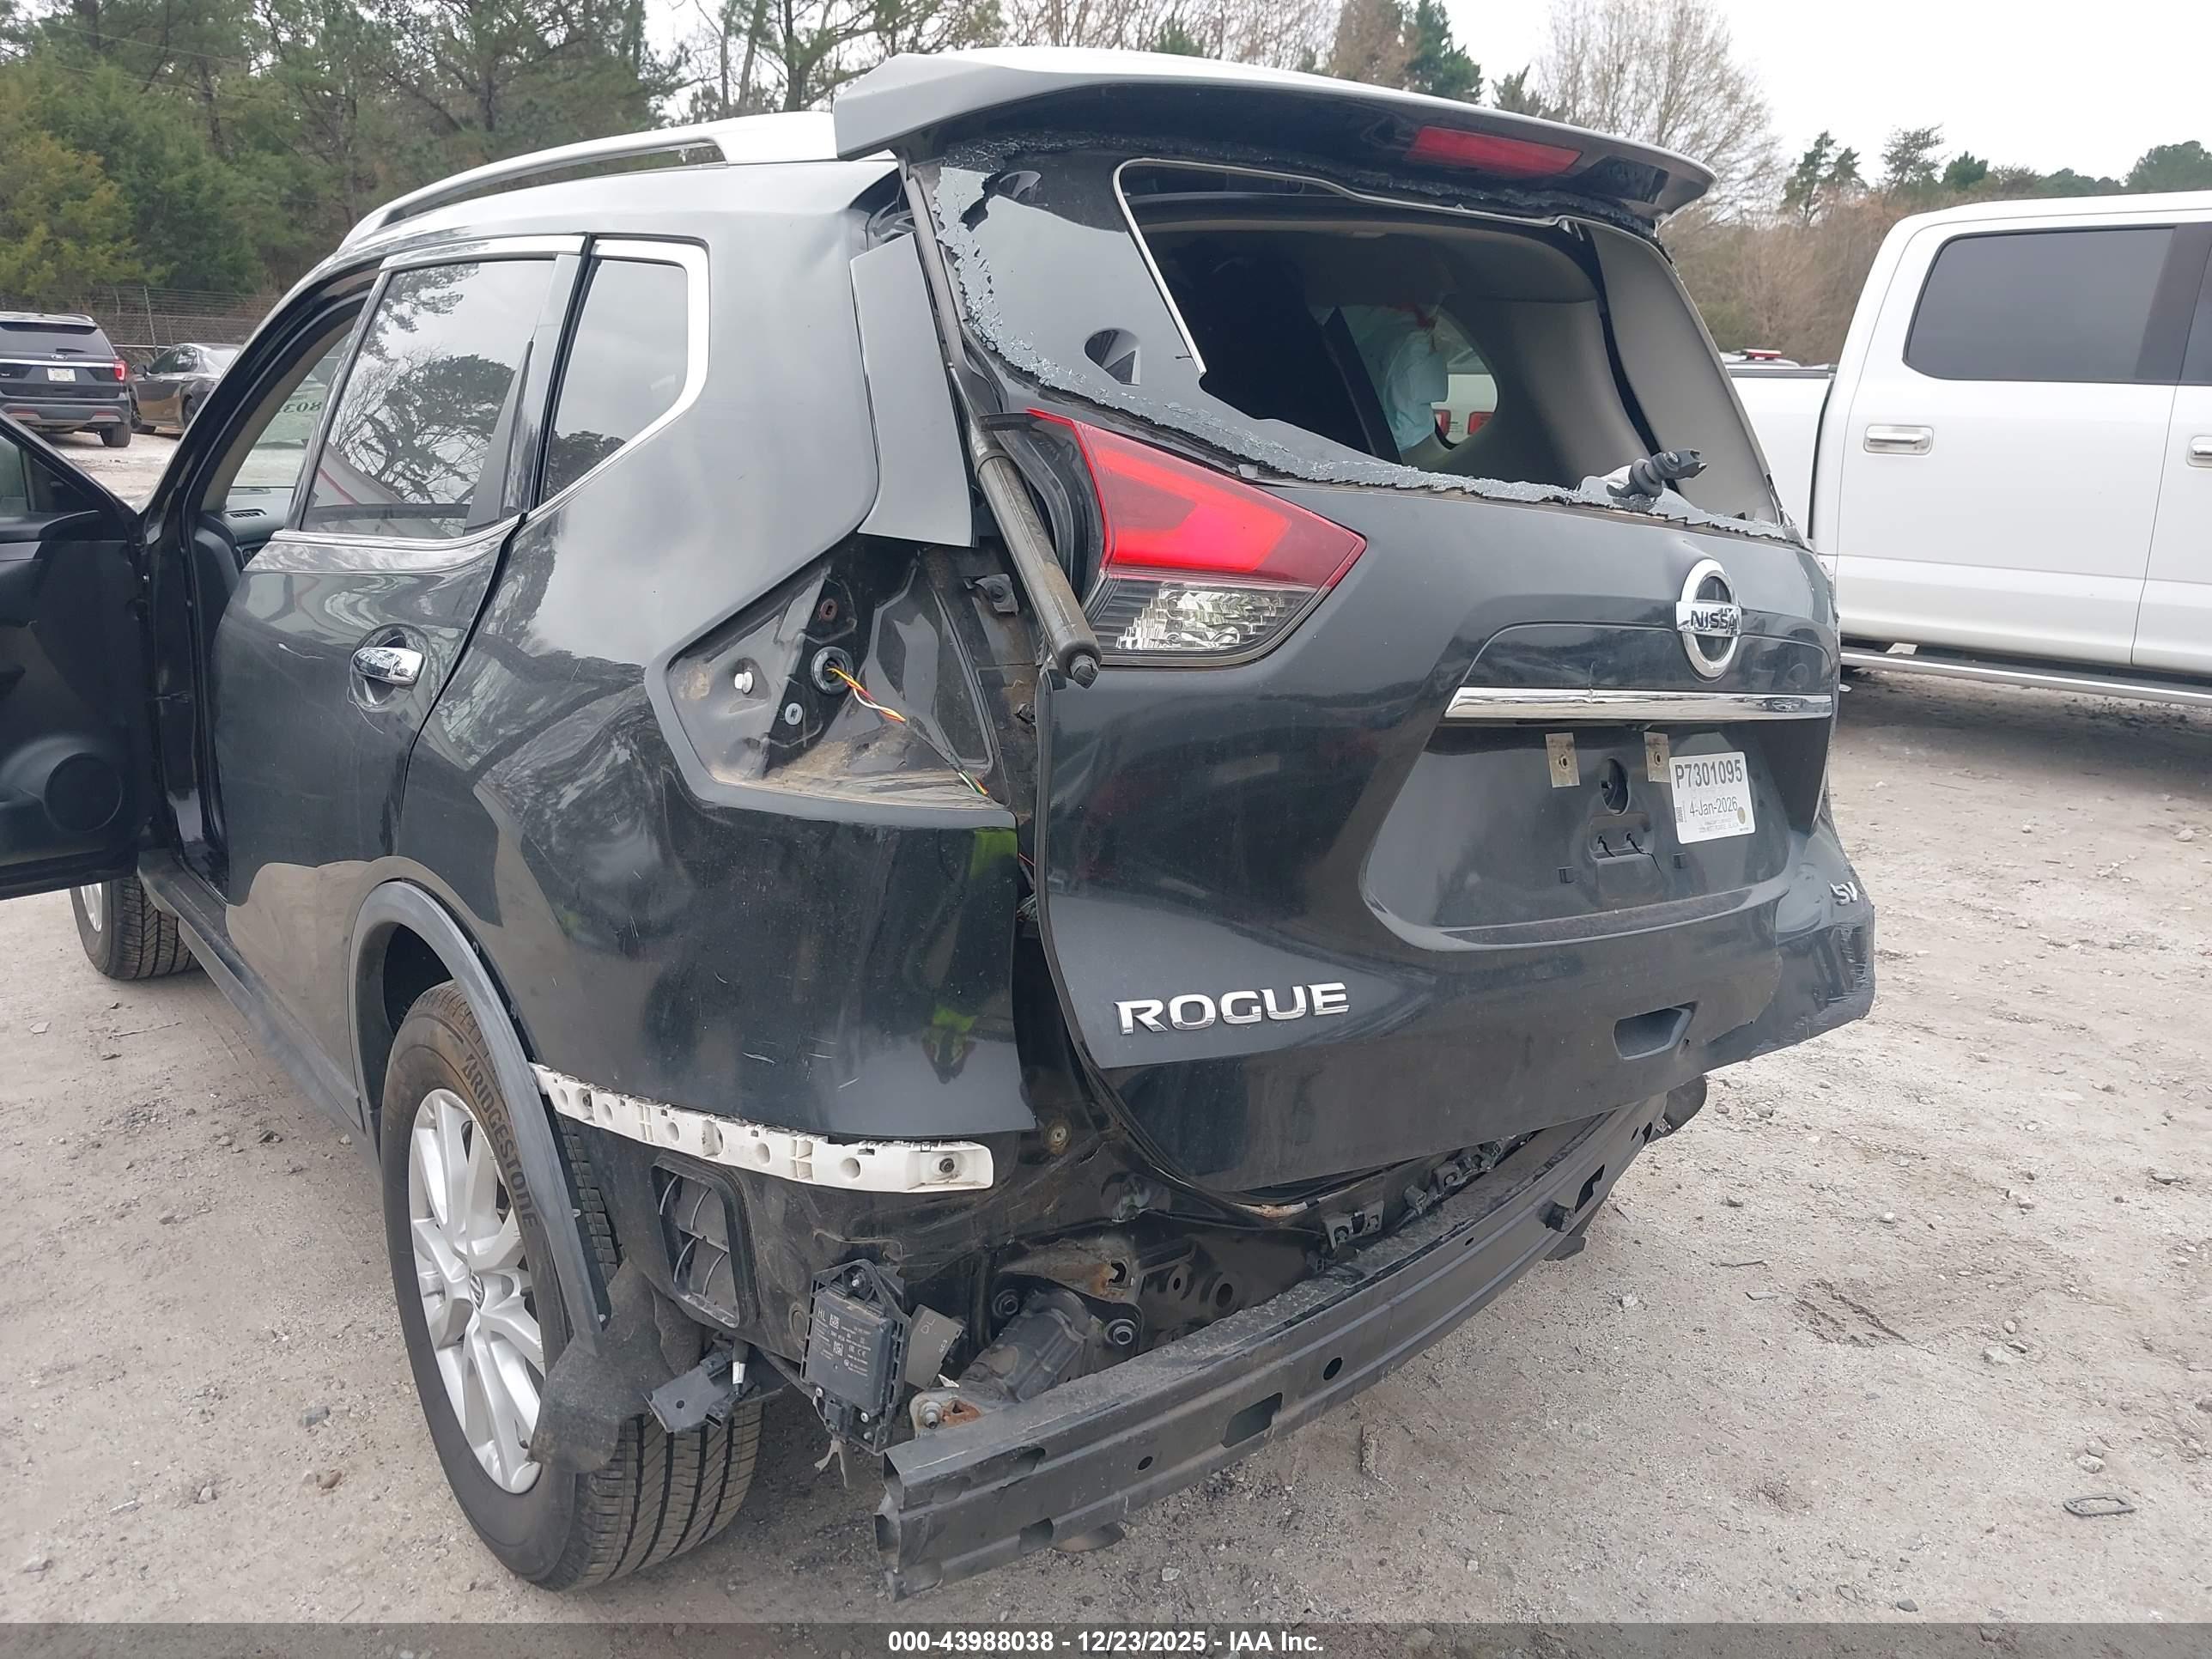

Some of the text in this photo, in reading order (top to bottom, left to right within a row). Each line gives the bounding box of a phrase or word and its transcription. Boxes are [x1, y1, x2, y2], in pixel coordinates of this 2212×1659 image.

[1674, 759, 1742, 789] P7301095
[1689, 796, 1738, 817] 4-Jan-2026
[1113, 981, 1350, 1035] ROGUE
[462, 1054, 539, 1229] BRIDGESTONE
